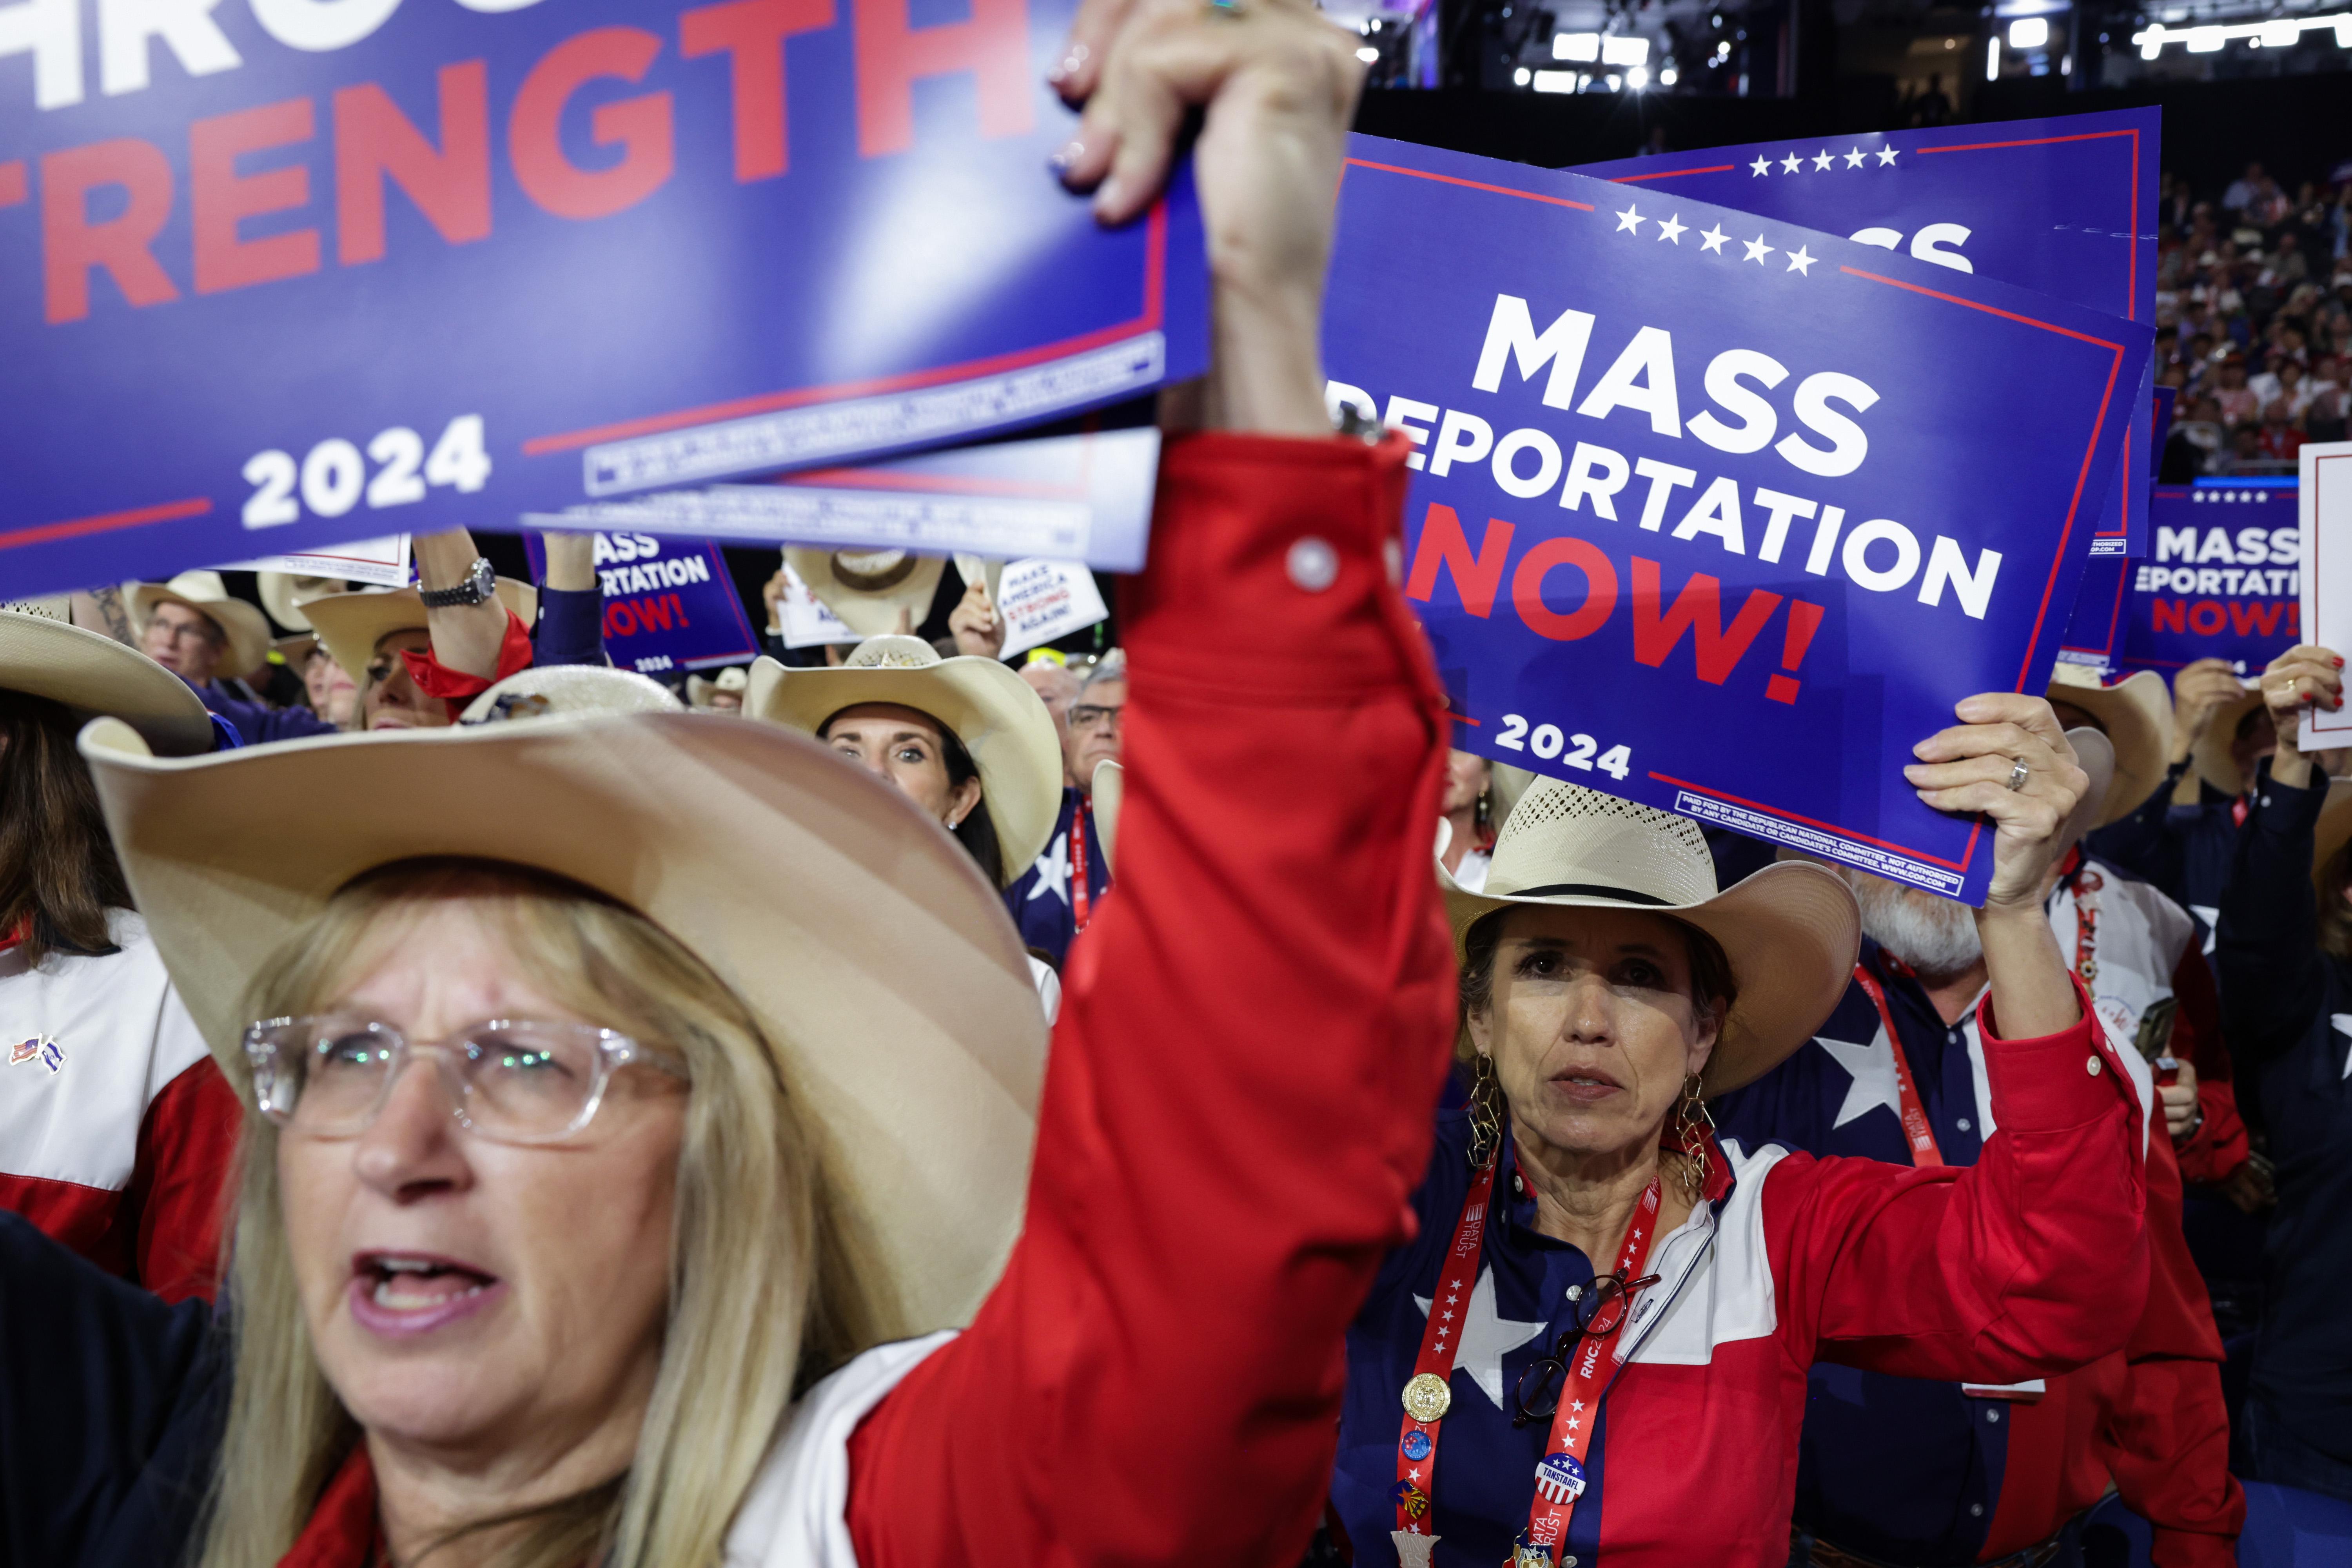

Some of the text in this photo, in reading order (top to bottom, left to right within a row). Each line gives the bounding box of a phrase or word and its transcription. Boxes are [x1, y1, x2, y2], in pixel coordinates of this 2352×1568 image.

[0, 0, 1038, 325] RENGTH
[1472, 294, 1881, 477] MASS
[243, 414, 492, 530] 2024
[2156, 526, 2299, 565] MASS
[1405, 502, 1825, 705] NOW!
[2152, 598, 2299, 637] NOW!
[1495, 714, 1631, 780] 2024
[1682, 795, 1702, 806] PAID
[1703, 802, 1719, 811] FOR
[1720, 807, 1731, 815] BY
[1732, 810, 1747, 819] THE
[1748, 815, 1798, 835] REPUBLICAN
[1798, 829, 1838, 848] NATIONAL
[1887, 858, 1906, 867] NOT
[1906, 864, 1959, 884] AUTHORIZED
[1691, 805, 1702, 813] BY
[1703, 808, 1720, 818] ANY
[1720, 813, 1766, 832] CANDIDATE
[1766, 827, 1779, 836] OR
[1779, 831, 1831, 852] CANDIDATE'S
[1881, 863, 1945, 888] WWW.GOP.COM
[1456, 1223, 1473, 1258] TRUST
[1468, 1221, 1481, 1250] DATA
[1543, 1467, 1578, 1490] TANSTAAFL
[1399, 1534, 1428, 1553] MINN
[1543, 1508, 1561, 1546] RUST
[1406, 1552, 1423, 1567] ES
